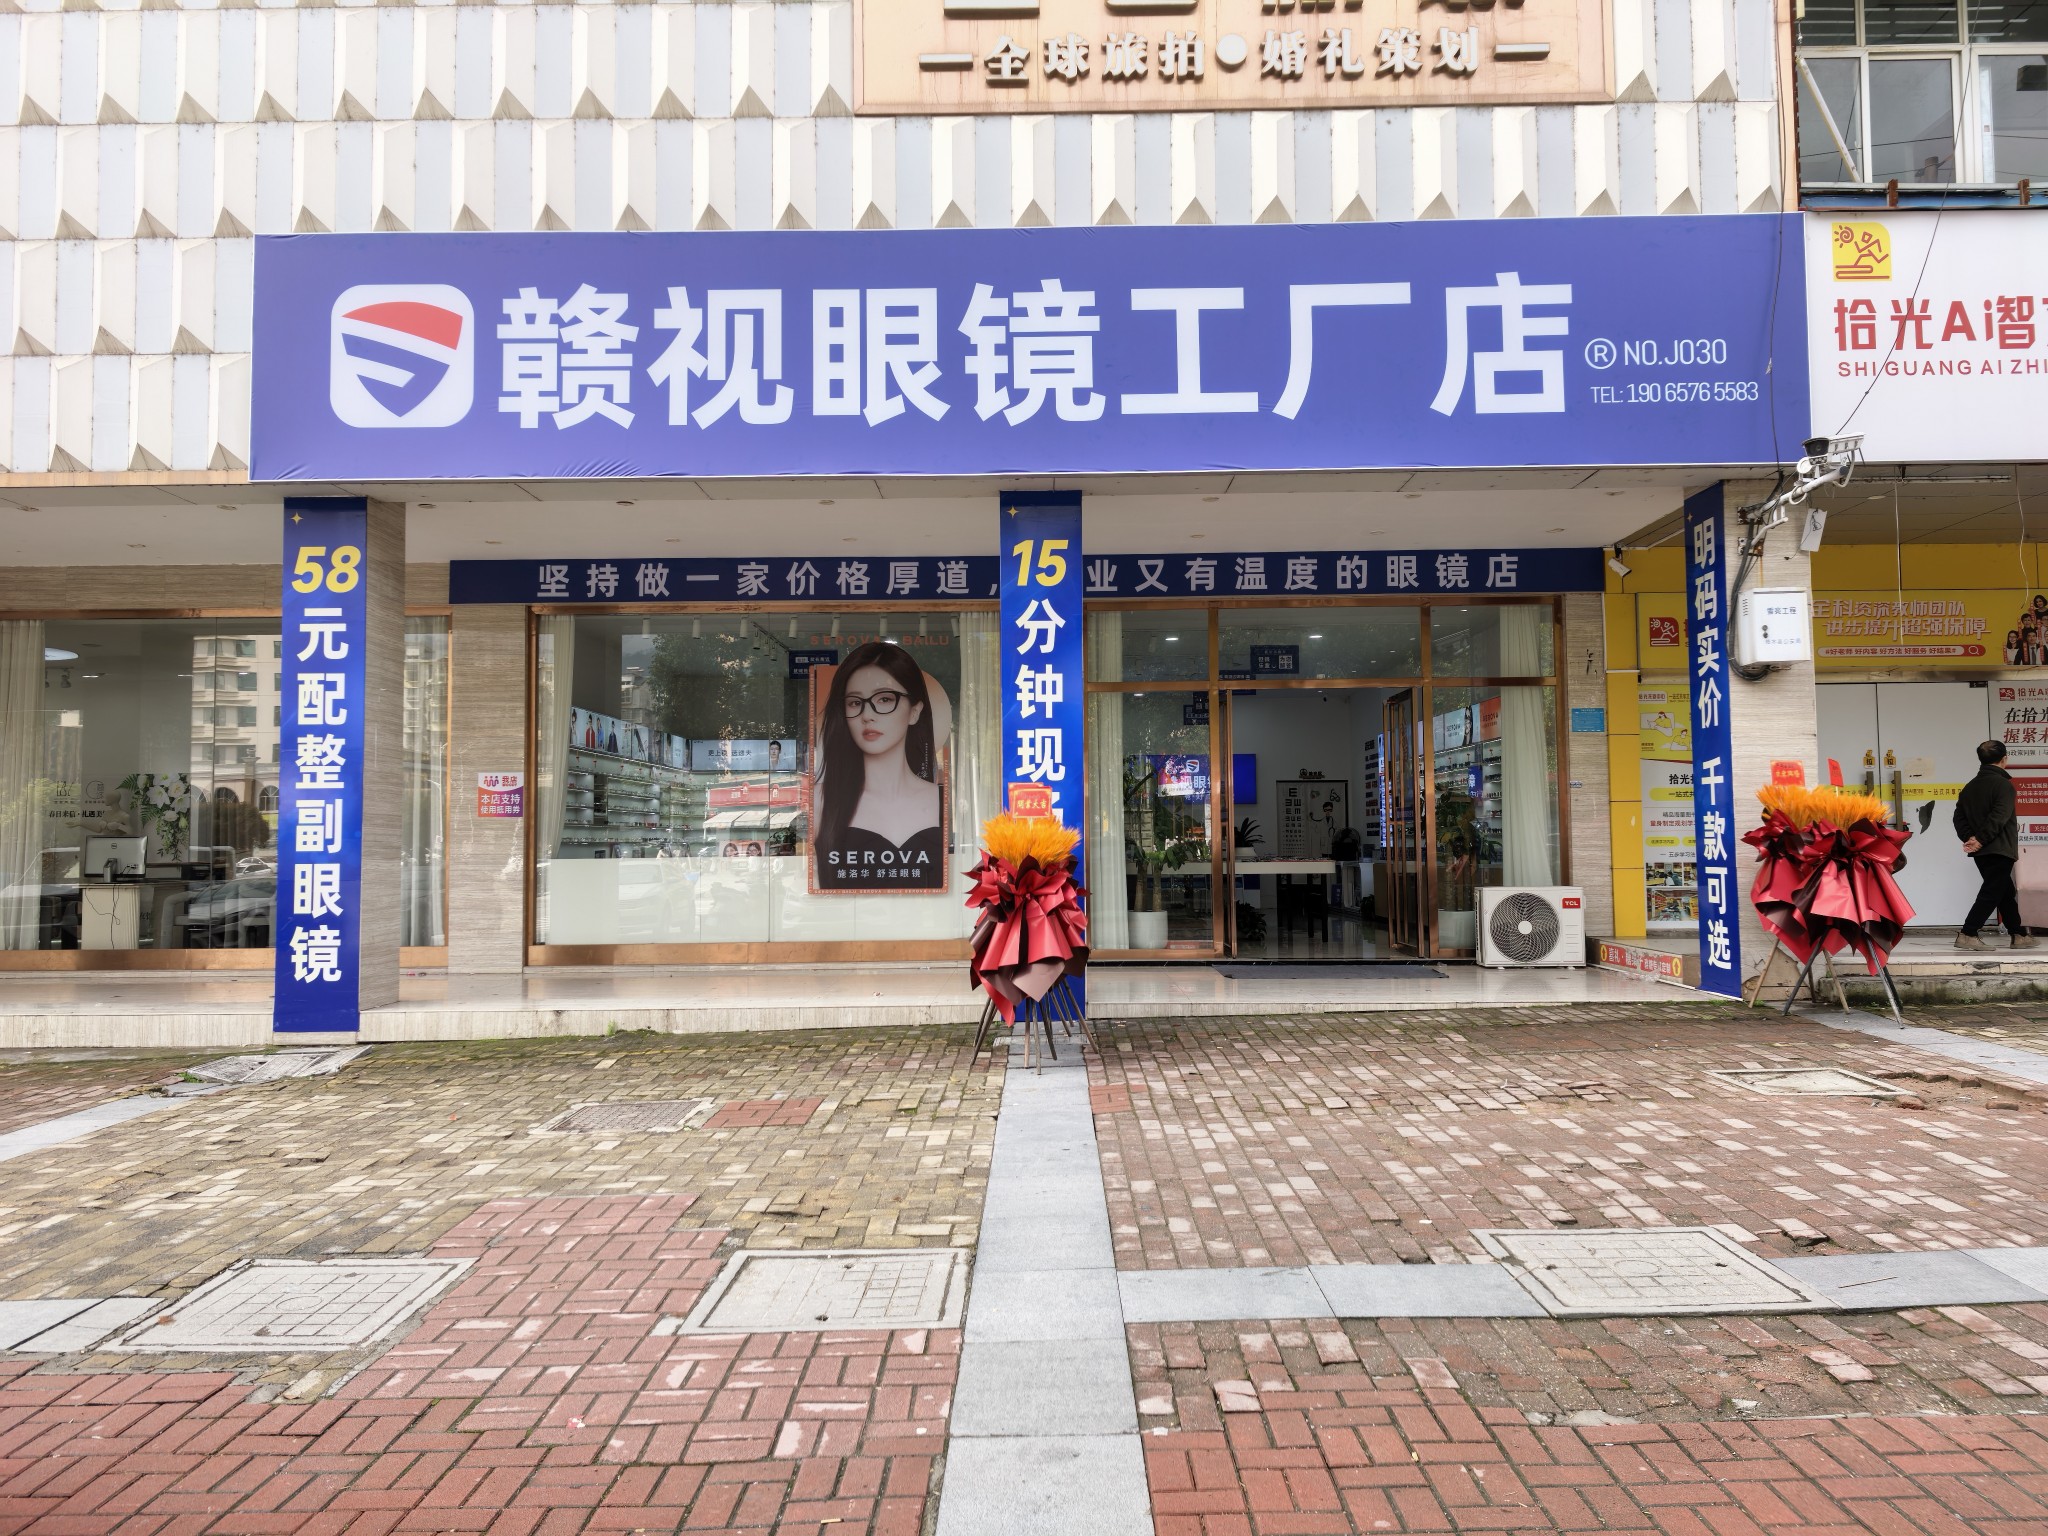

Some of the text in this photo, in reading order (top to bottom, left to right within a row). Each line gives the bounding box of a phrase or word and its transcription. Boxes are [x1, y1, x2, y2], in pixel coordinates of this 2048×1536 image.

[1834, 295, 2048, 351] 拾光Ai智
[497, 272, 1575, 430] 赣视眼镜工厂店
[1086, 553, 1520, 594] 业又有温度的眼镜店
[1694, 516, 1732, 971] 明码实价 千款可选
[481, 793, 521, 805] 本店支持
[828, 850, 931, 865] SEROVA
[837, 868, 921, 879] 施洛华 舒适眼镜
